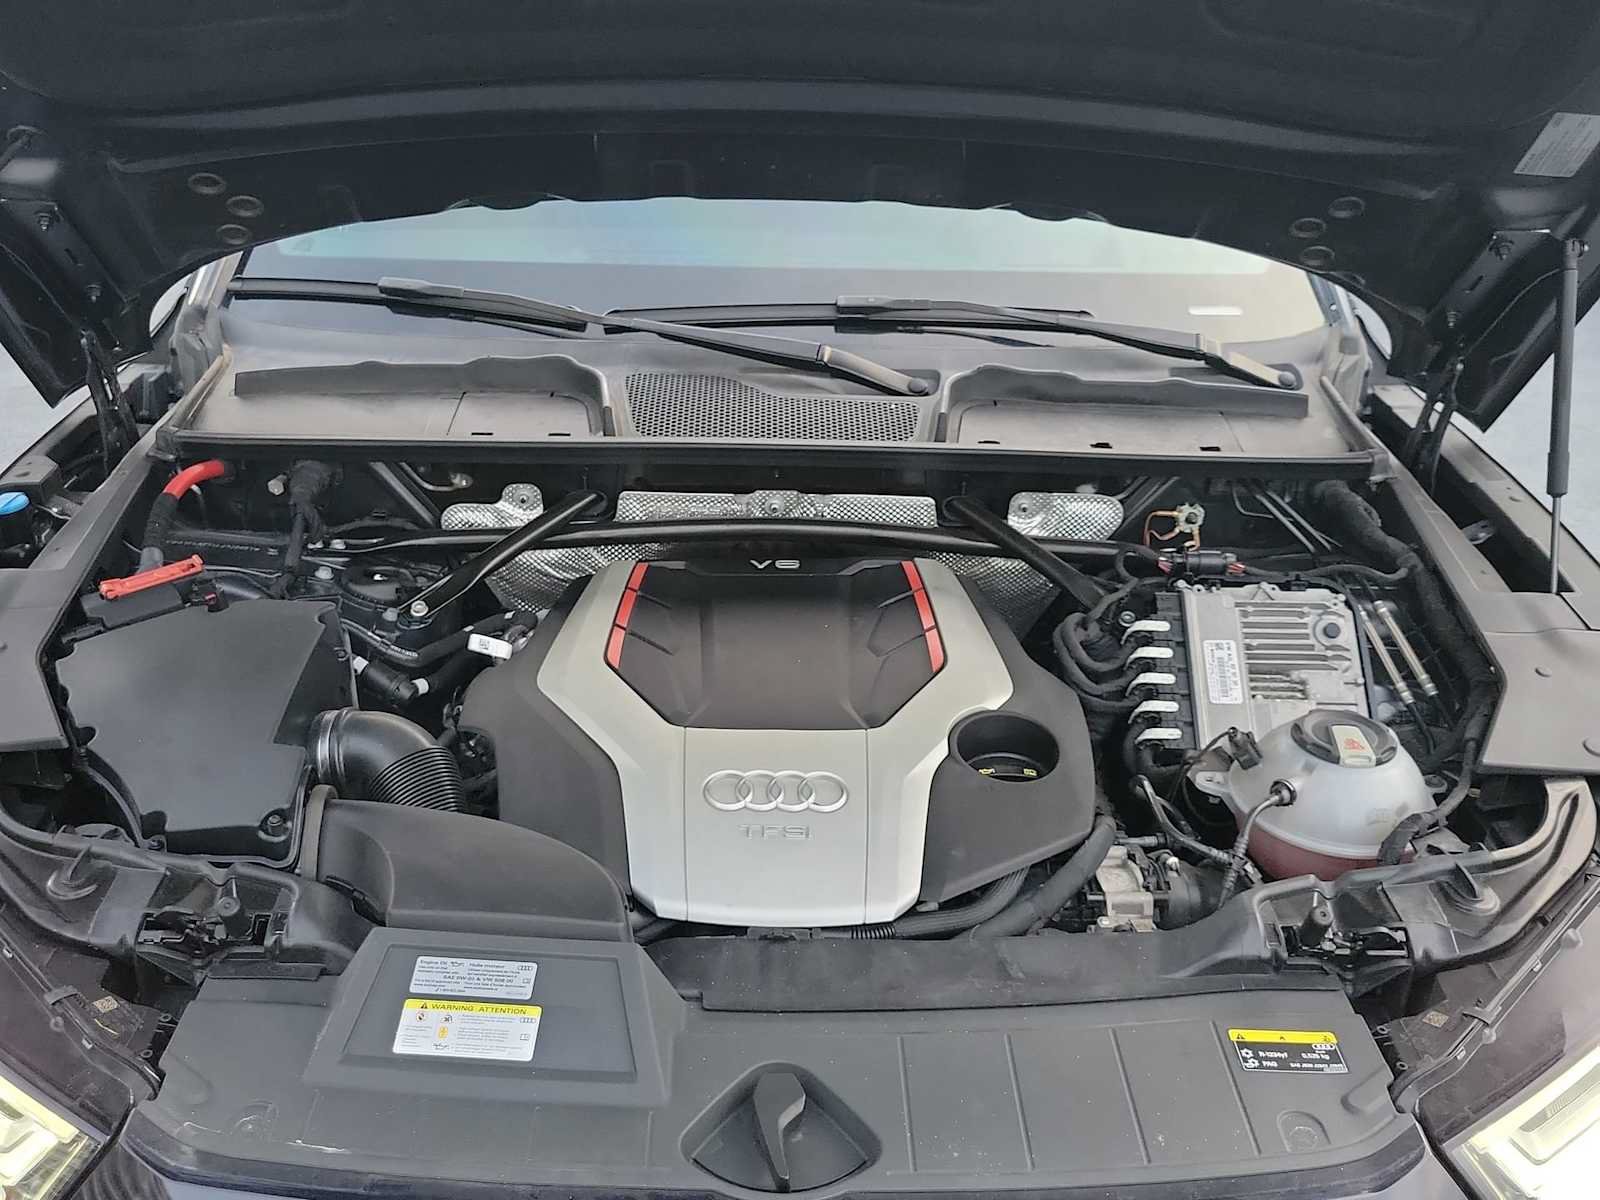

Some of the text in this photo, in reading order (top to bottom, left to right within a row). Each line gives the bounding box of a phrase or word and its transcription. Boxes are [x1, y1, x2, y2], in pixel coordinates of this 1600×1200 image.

[749, 559, 801, 569] V6
[738, 824, 811, 841] TFSI
[431, 1003, 528, 1015] WARNING ATTENTION
